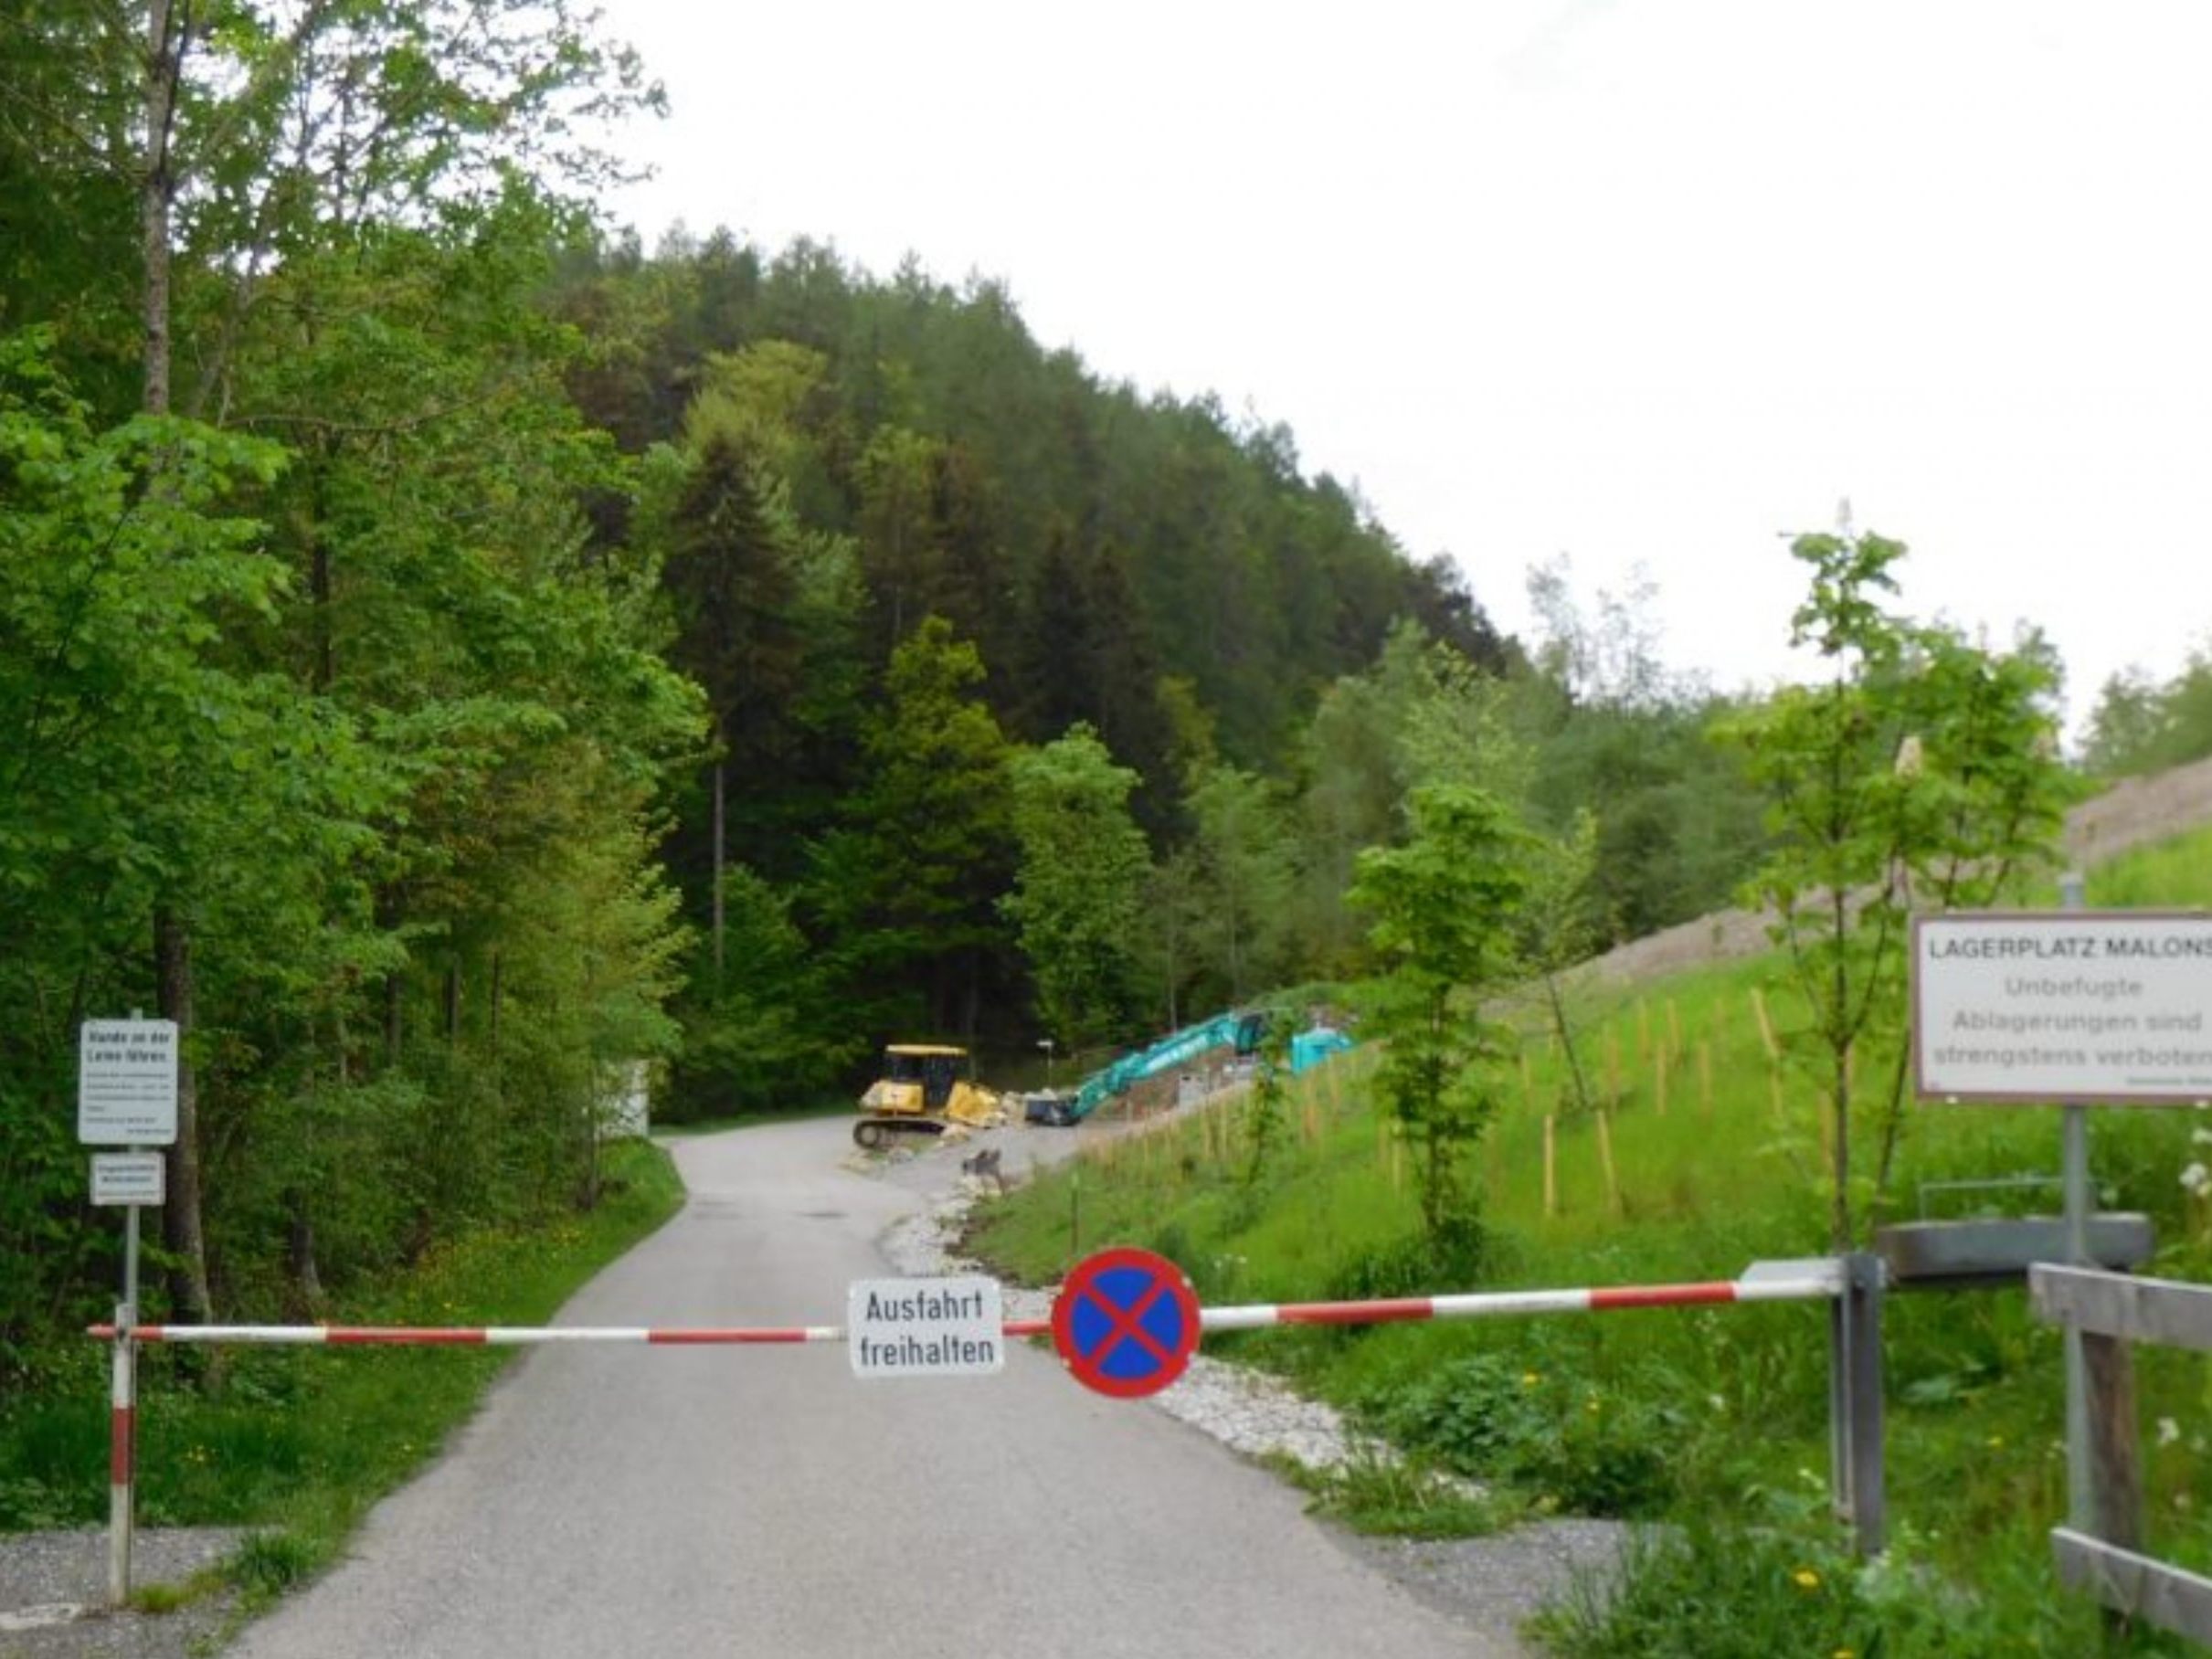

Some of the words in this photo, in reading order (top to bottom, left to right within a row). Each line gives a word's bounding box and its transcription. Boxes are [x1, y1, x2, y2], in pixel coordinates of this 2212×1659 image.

[1930, 937, 2095, 958] LAGERPLATZ
[2005, 977, 2142, 1002] Unbefugte
[1953, 1010, 2137, 1034] Ablagerungen
[2147, 1011, 2203, 1031] sind
[1933, 1047, 2086, 1069] strengstens
[866, 1290, 983, 1323] Ausfahrt
[860, 1335, 994, 1367] freihalten
